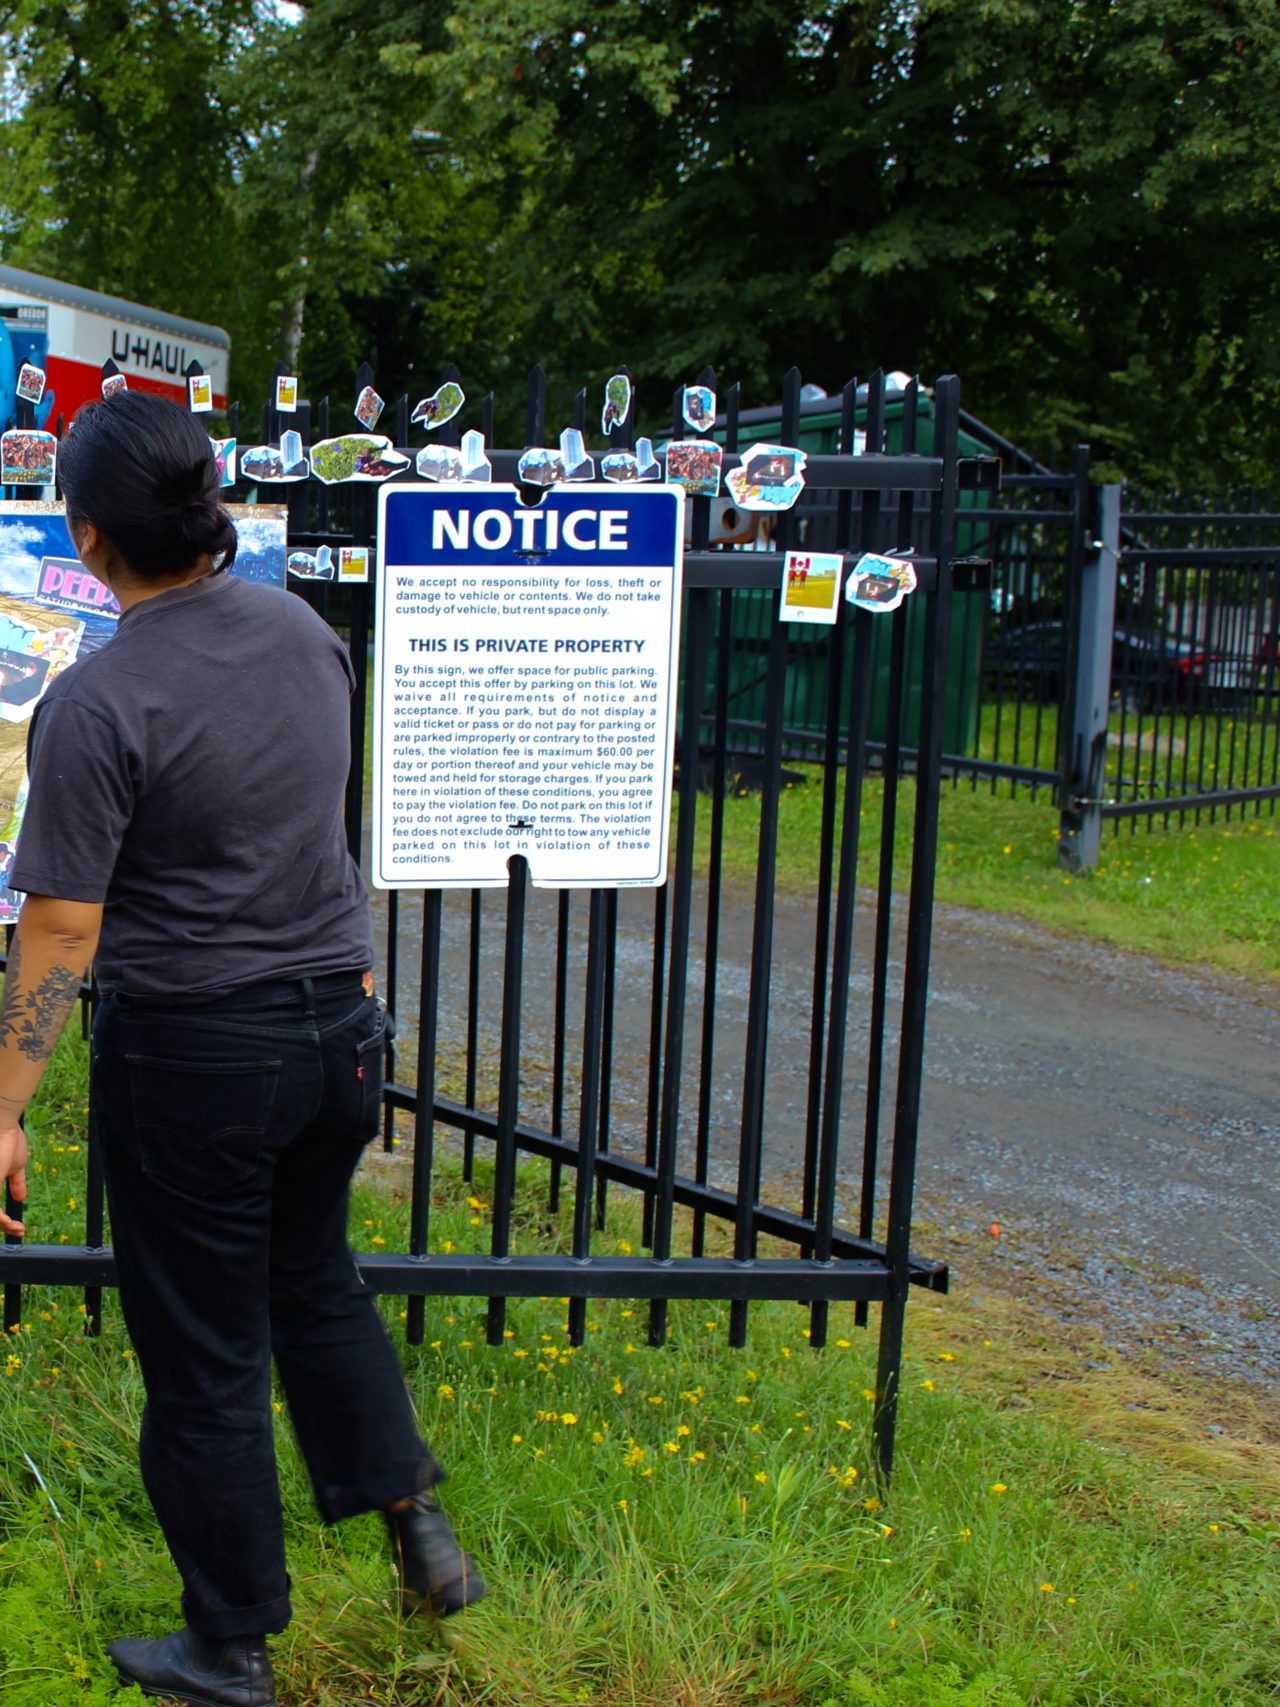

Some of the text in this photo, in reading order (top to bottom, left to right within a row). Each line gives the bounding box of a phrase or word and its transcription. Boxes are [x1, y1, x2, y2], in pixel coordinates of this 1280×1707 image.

[111, 328, 189, 377] U-HAUL
[431, 508, 629, 551] NOTICE
[395, 577, 645, 590] We accept responsibility for loss, theft
[395, 590, 662, 603] damage to vehicle contents. We do not take
[395, 604, 610, 617] custody vehicle, but rent space only.
[408, 638, 645, 654] THIS IS PRIVATE PROPERTY
[394, 664, 658, 678] By this sign, offer space for public parking.
[394, 678, 658, 692] You accept this offer by parking this lot. We
[393, 691, 658, 704] waive all requirements notice and
[393, 705, 645, 719] acceptance. If you park, but do not display
[393, 719, 642, 732] valid ticket pass do not pay for parking
[392, 732, 656, 746] are parked improperly contrary the posted
[393, 746, 655, 759] rules, the violation fee maximum $60.00 per
[392, 759, 655, 773] day portion thereof and your vehicle may be
[392, 772, 654, 786] towed and held for storage charges. you park
[392, 786, 654, 799] here violation these conditions, you agree
[392, 799, 643, 812] to pay the violation fee. Do not park this lot
[392, 813, 652, 825] you do not agree to these terms. The violation
[392, 826, 651, 839] fee does not exclude to tow any vehicle
[392, 839, 651, 852] parked this lot violation these
[391, 854, 454, 864] conditions.
